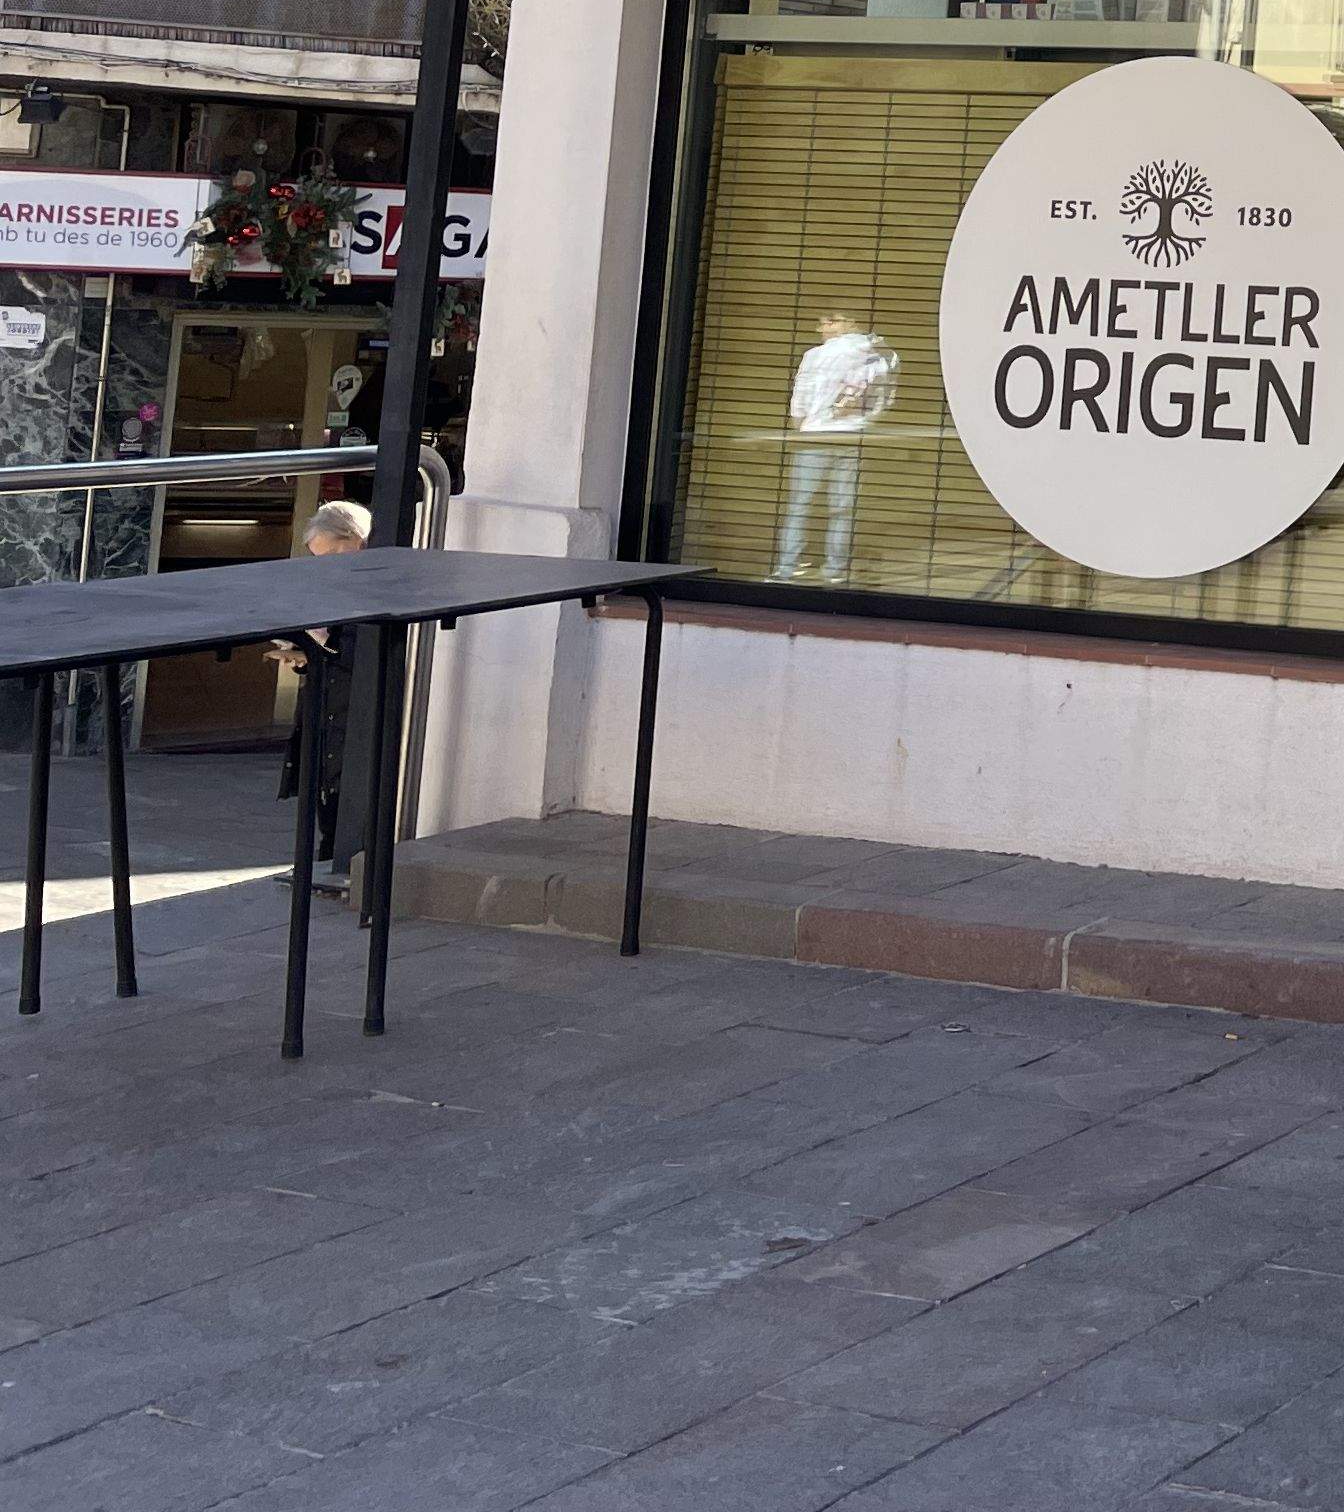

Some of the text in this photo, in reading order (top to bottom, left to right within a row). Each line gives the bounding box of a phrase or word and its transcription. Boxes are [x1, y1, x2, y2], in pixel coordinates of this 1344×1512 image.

[0, 226, 178, 248] b tu des de 1960
[1050, 199, 1292, 227] EST. 1830
[1003, 275, 1320, 349] AMETLLER
[994, 344, 1316, 446] ORIGEN
